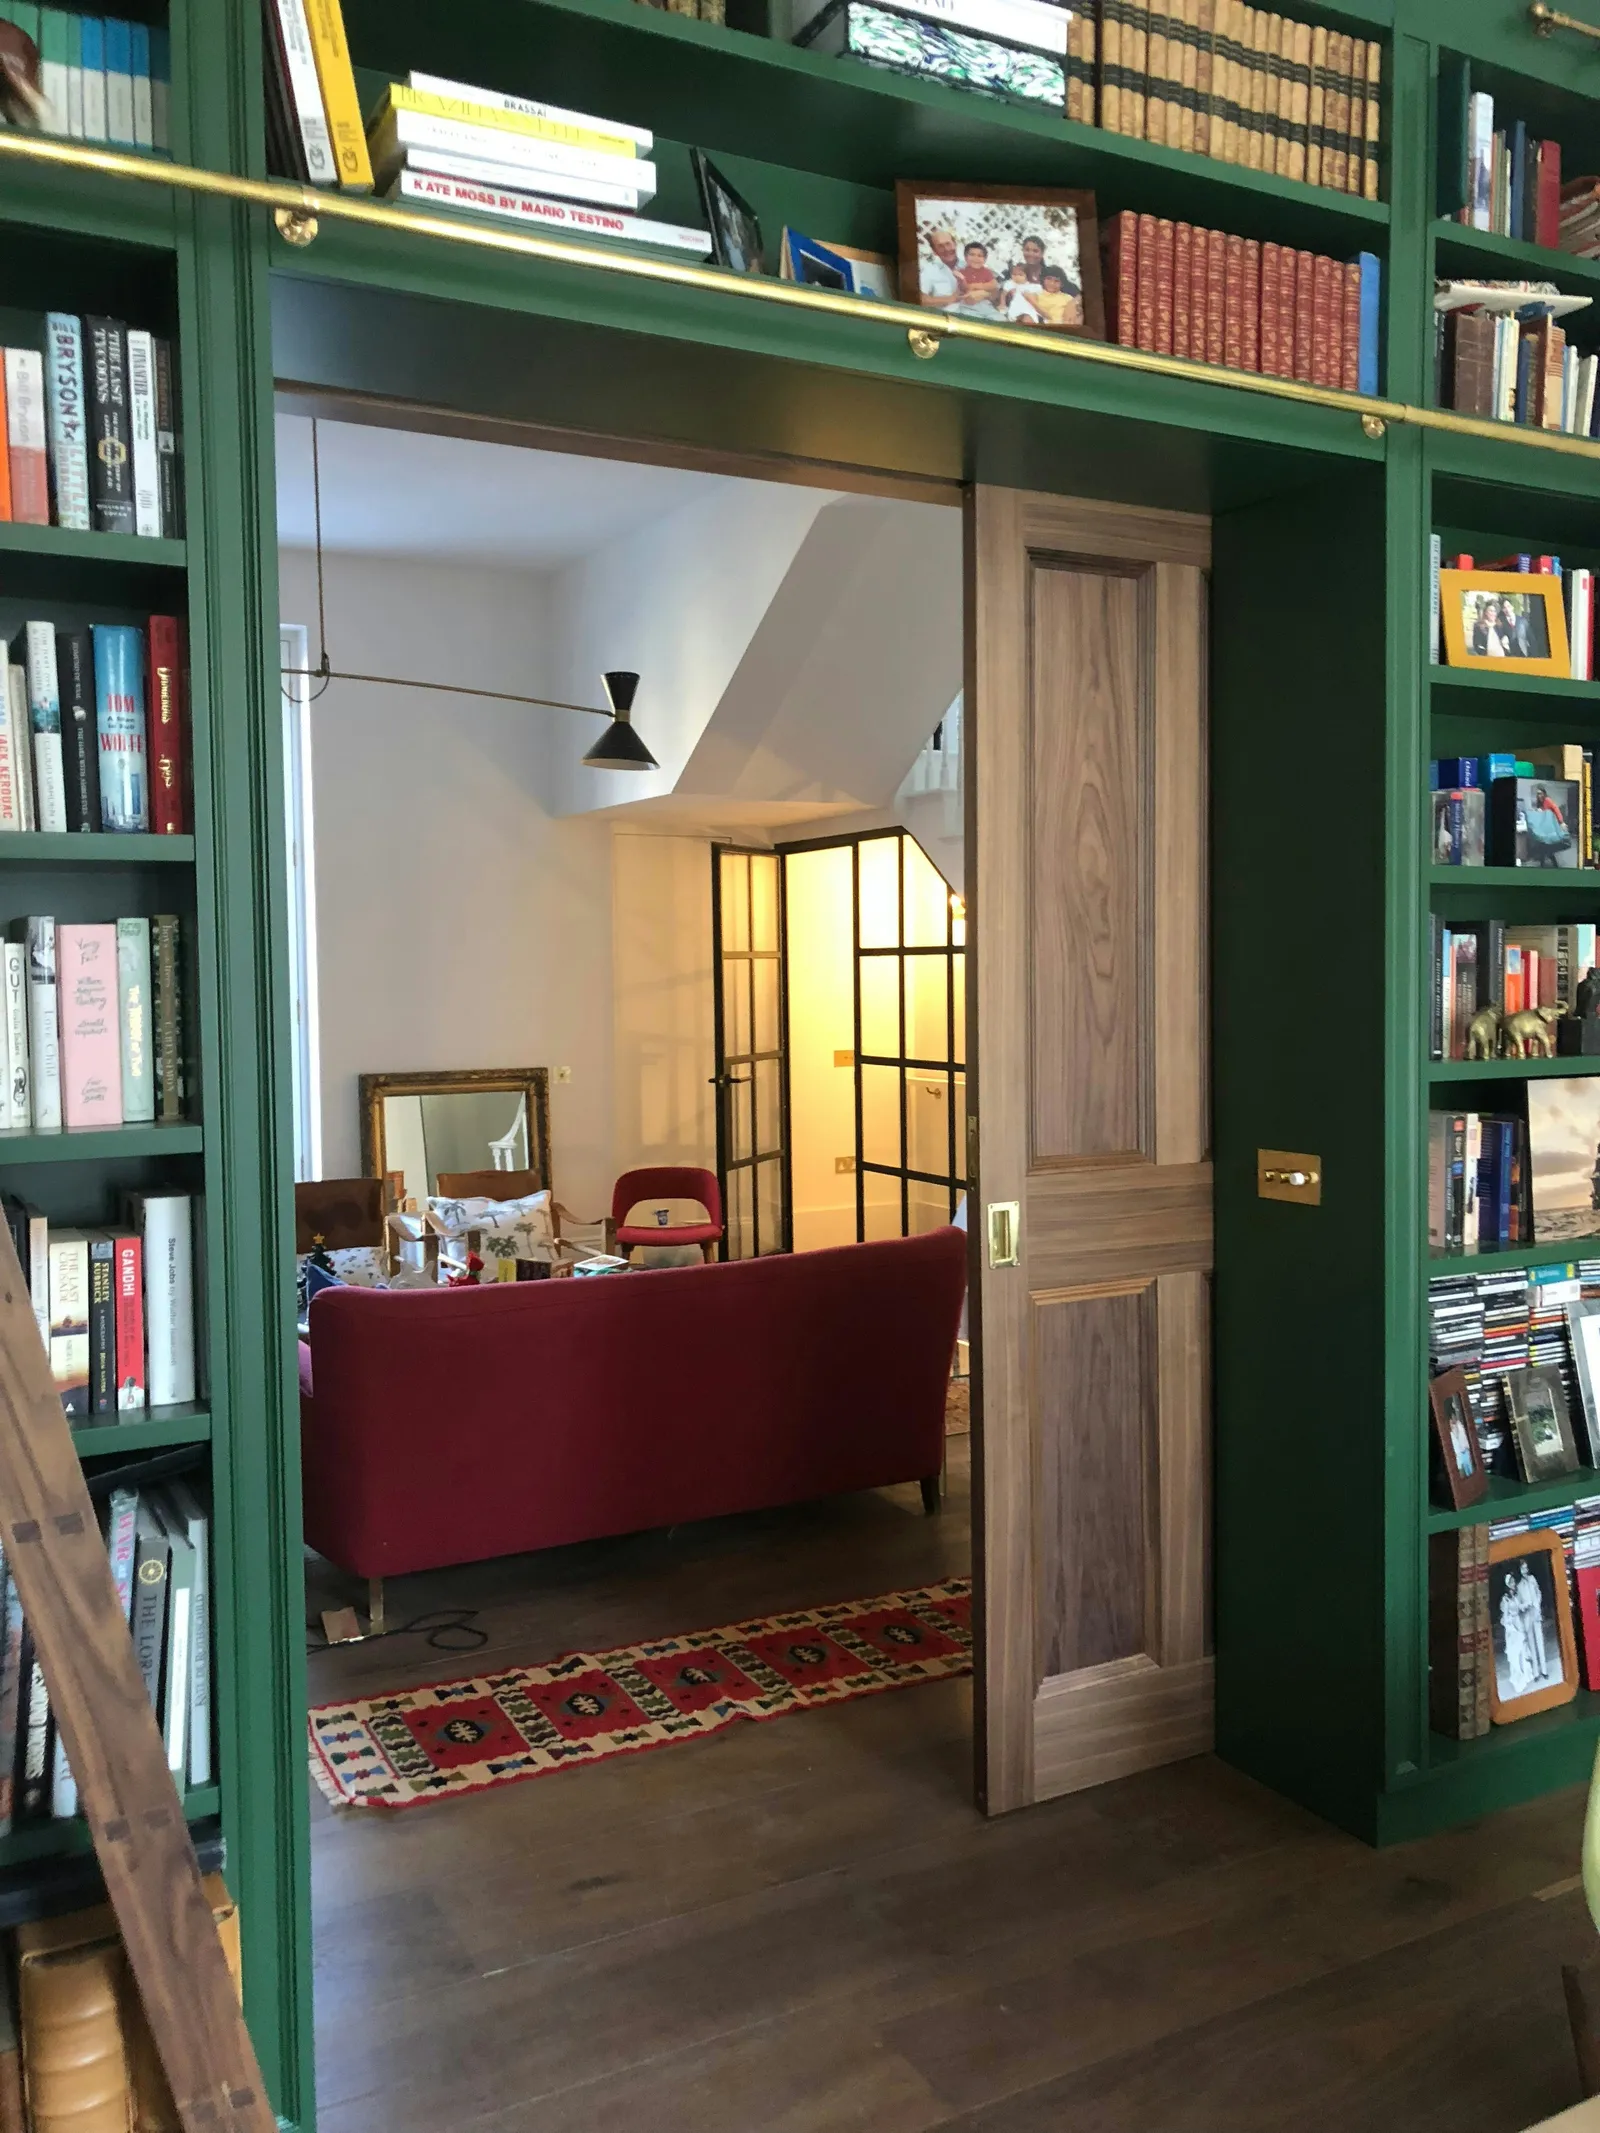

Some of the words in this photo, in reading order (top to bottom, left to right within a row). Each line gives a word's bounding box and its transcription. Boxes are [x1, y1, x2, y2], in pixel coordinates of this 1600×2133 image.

[455, 187, 496, 205] MOSS
[499, 196, 517, 210] BY
[521, 201, 565, 219] MARIO
[570, 210, 625, 231] TESTINO
[94, 328, 109, 404] TYCOONS
[108, 330, 122, 364] THE
[56, 334, 79, 417] BRYSON
[110, 366, 123, 406] LAST
[131, 348, 148, 396] FINANCIER
[107, 694, 135, 713] TOM
[1, 766, 13, 819] KEROUAC
[44, 1010, 54, 1039] Love
[45, 1043, 56, 1077] Child
[168, 1238, 176, 1261] Steve
[59, 1251, 69, 1304] CRUSADE
[69, 1277, 79, 1304] LAST
[94, 1262, 103, 1304] KUBRICK
[101, 1262, 109, 1302] STANLEY
[122, 1249, 135, 1296] GANDHI
[168, 1264, 176, 1284] Jobs
[116, 1512, 133, 1561] WAR
[141, 1595, 157, 1631] THE
